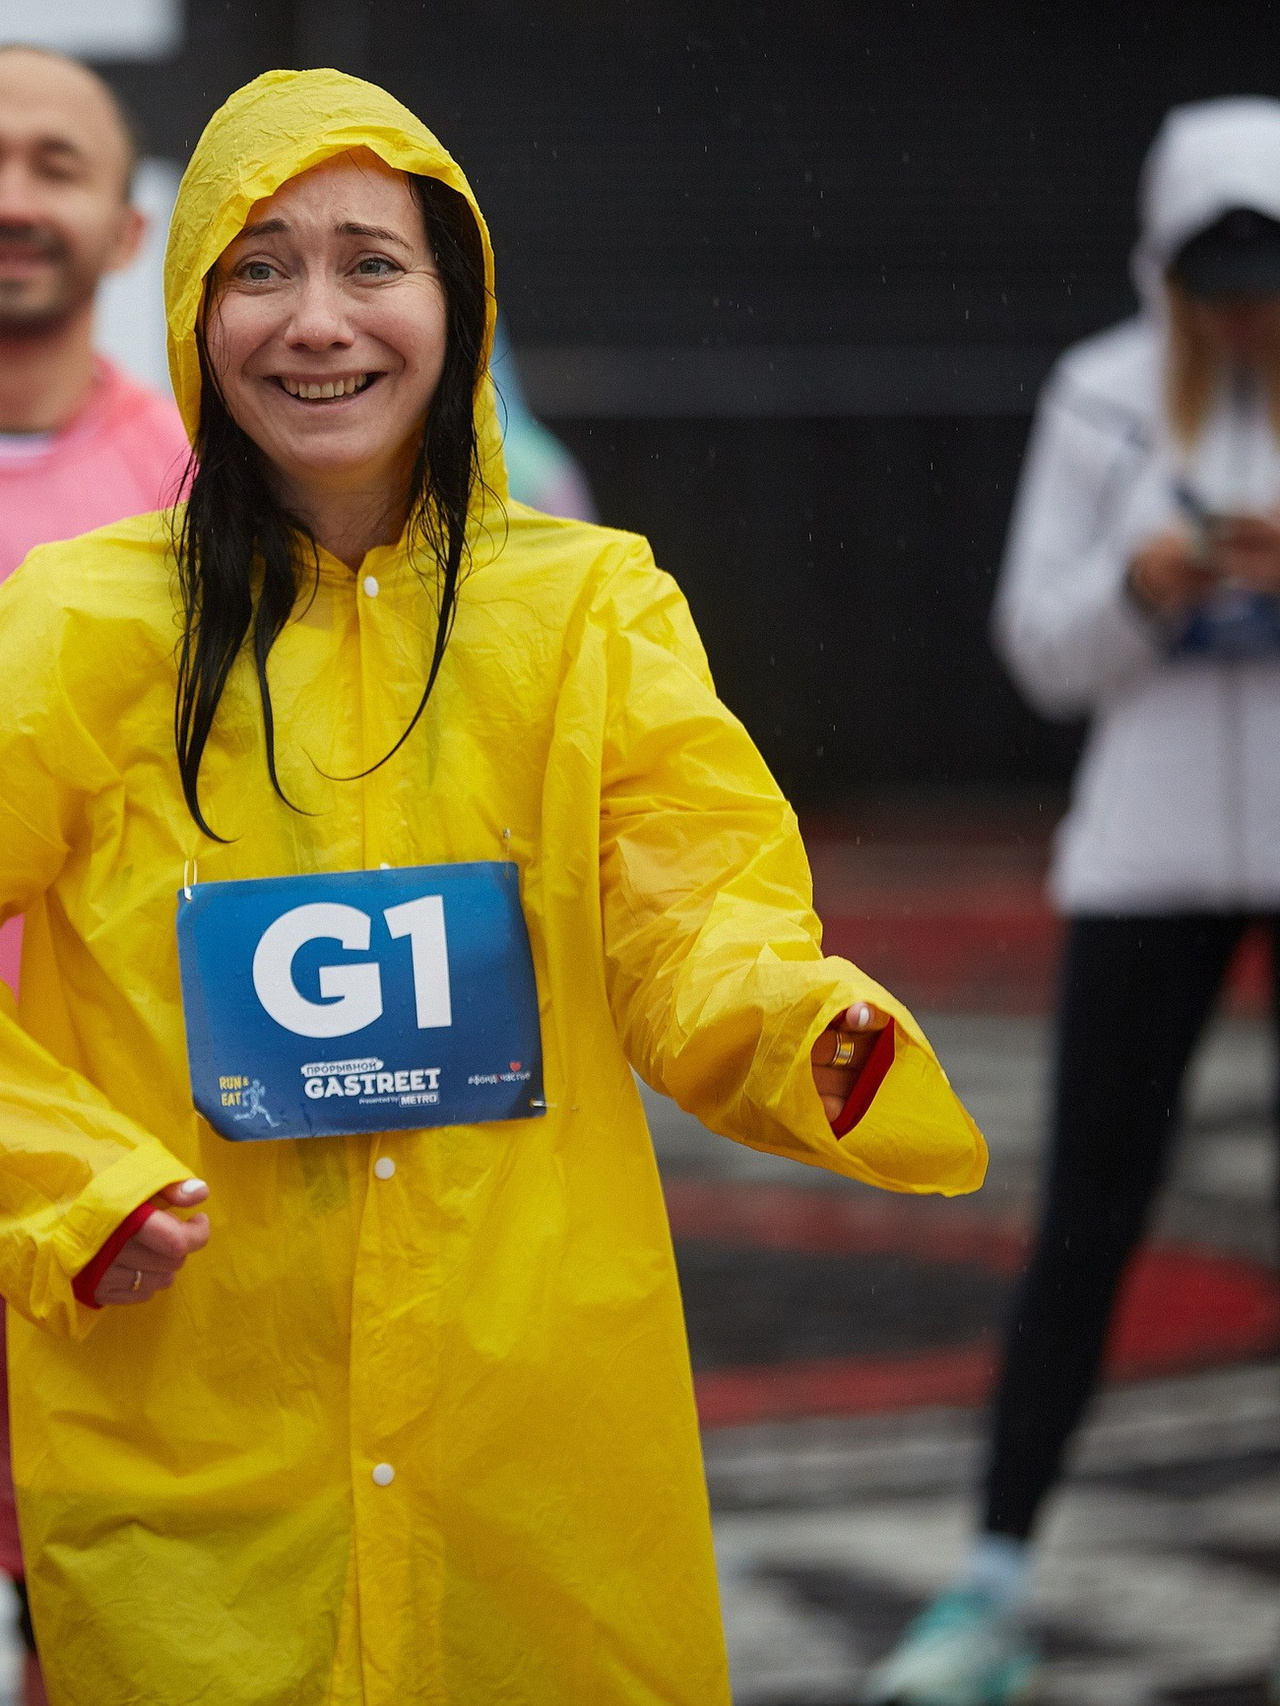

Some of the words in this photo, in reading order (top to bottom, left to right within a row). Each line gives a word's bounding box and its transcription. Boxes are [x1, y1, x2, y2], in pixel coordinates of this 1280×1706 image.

[252, 894, 452, 1039] G1
[219, 1075, 242, 1090] RUN
[304, 1067, 441, 1099] GASTREET
[221, 1092, 241, 1107] EAT
[400, 1093, 437, 1106] METRO
